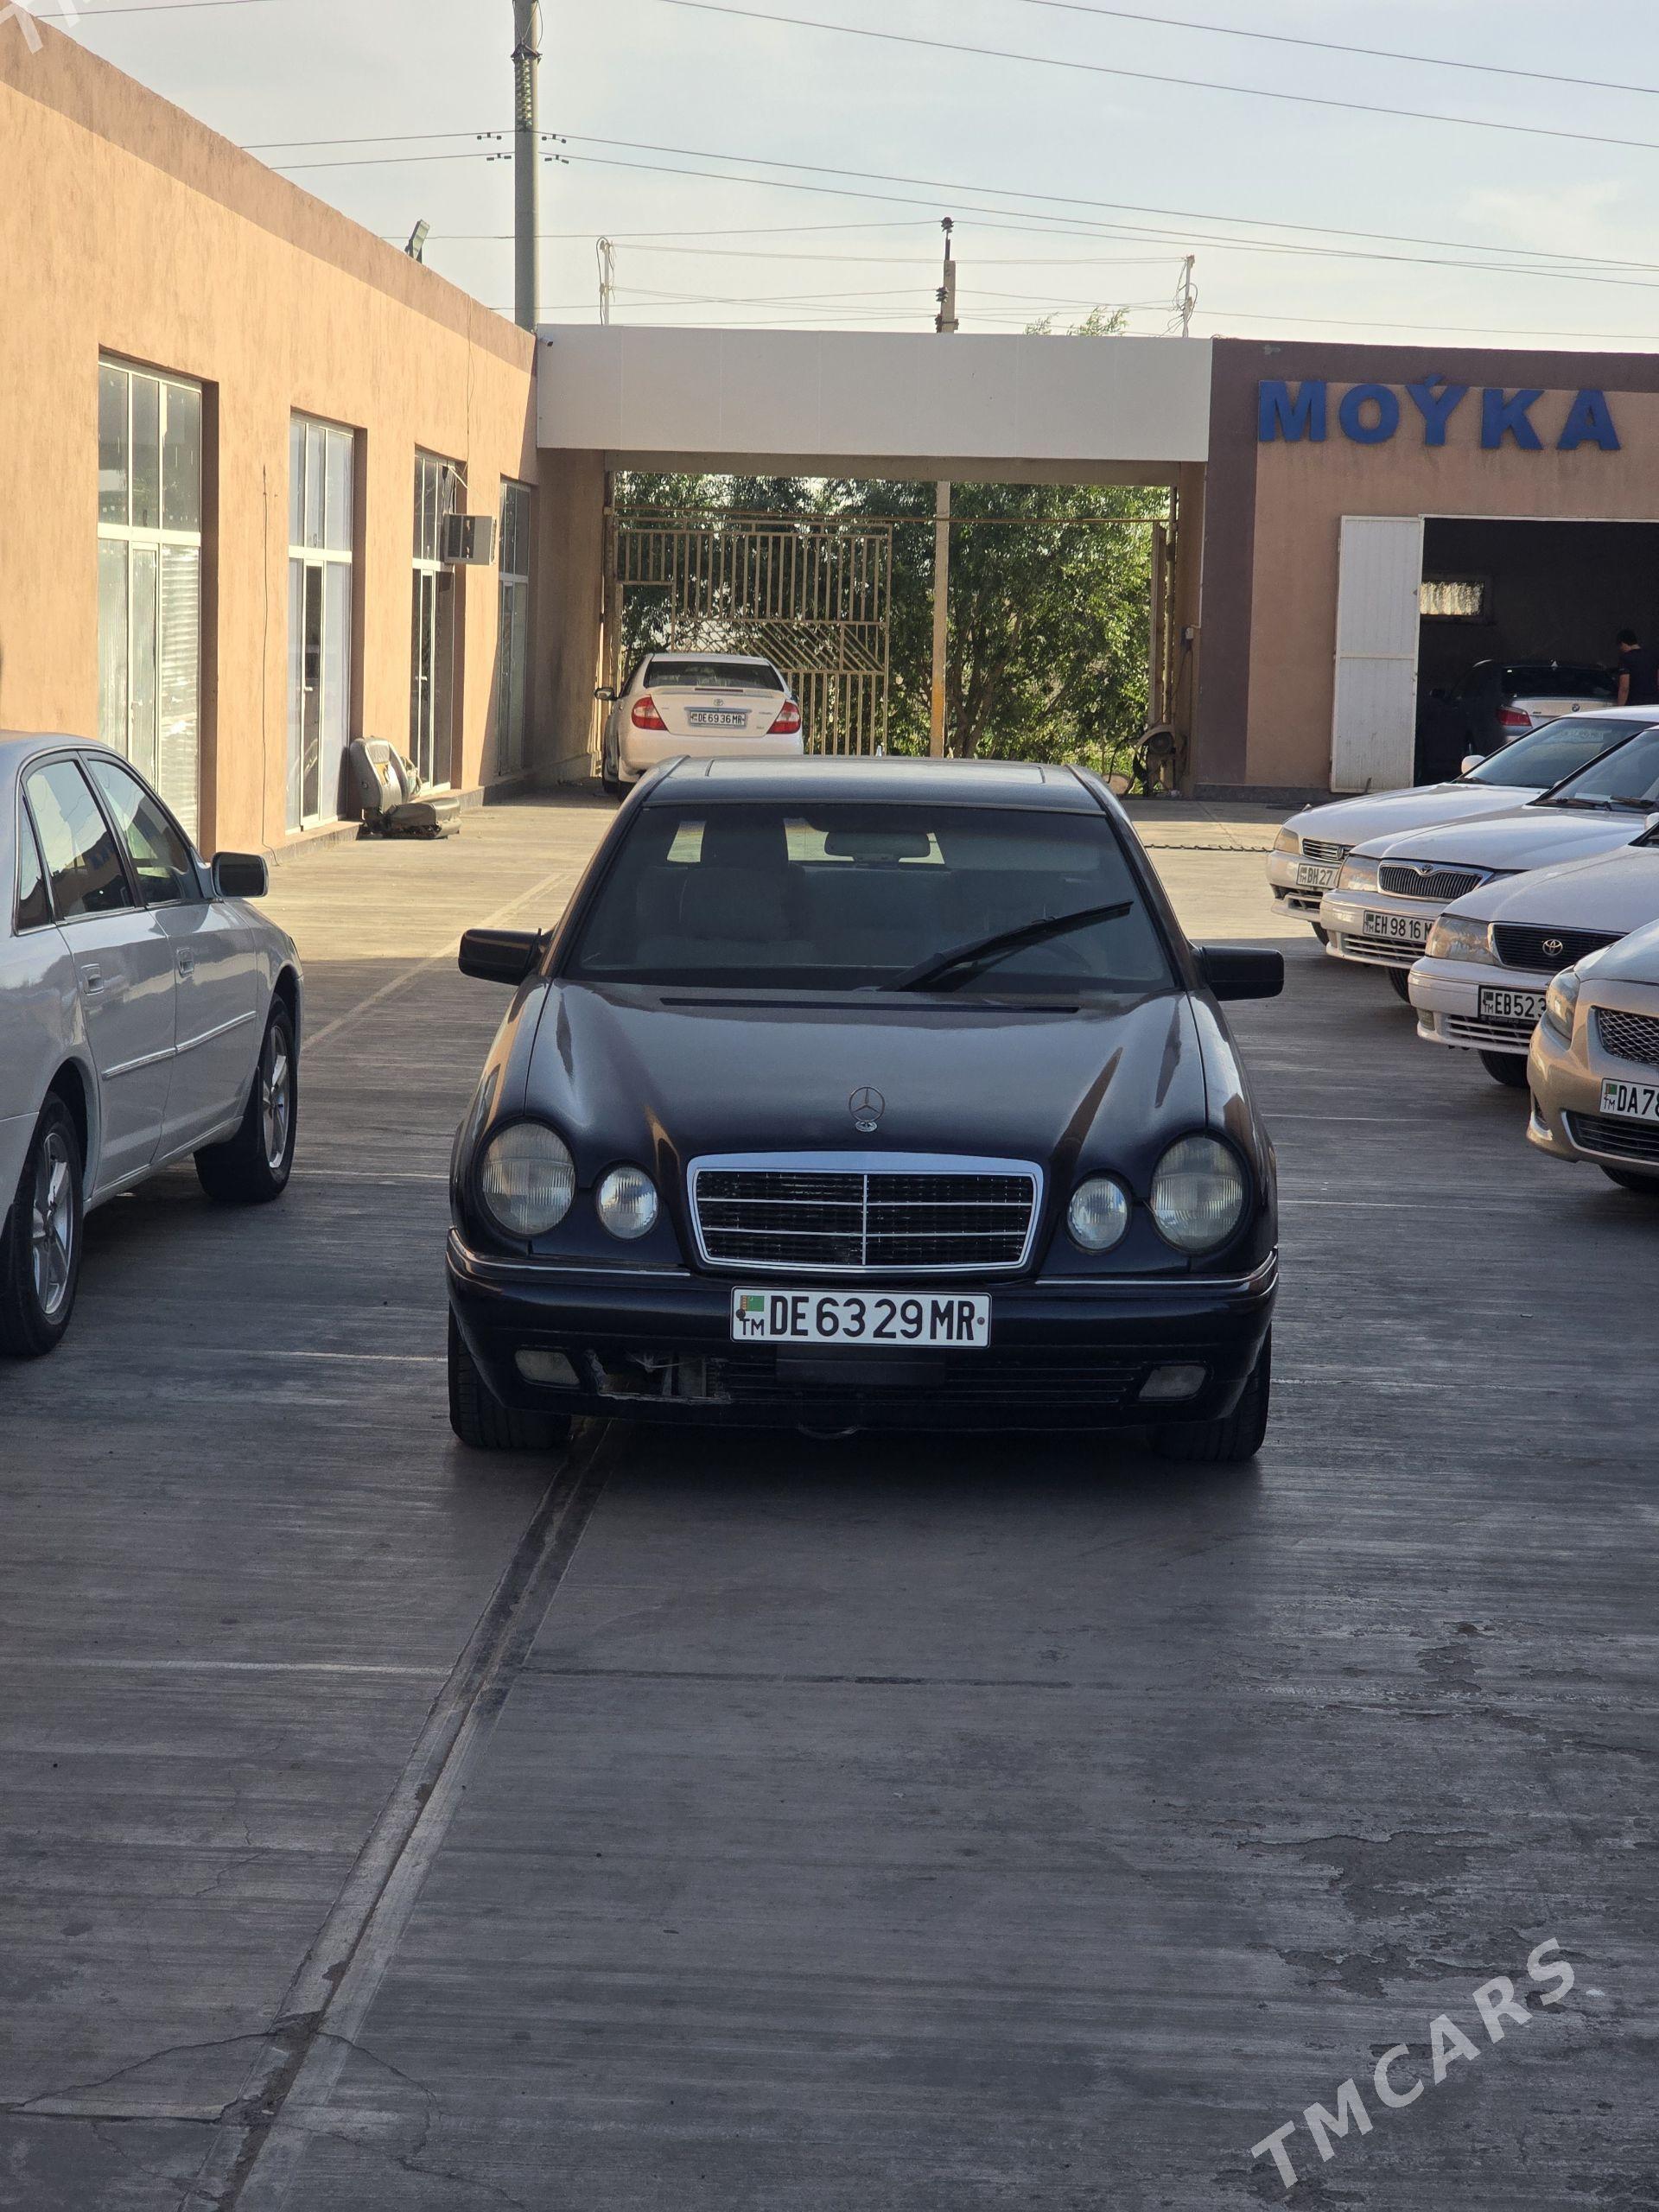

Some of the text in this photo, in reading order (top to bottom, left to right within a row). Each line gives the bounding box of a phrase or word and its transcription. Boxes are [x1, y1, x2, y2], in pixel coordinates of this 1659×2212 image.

[1259, 374, 1621, 450] MOÝKA
[1307, 867, 1339, 887] BH27
[739, 1318, 765, 1336] TM
